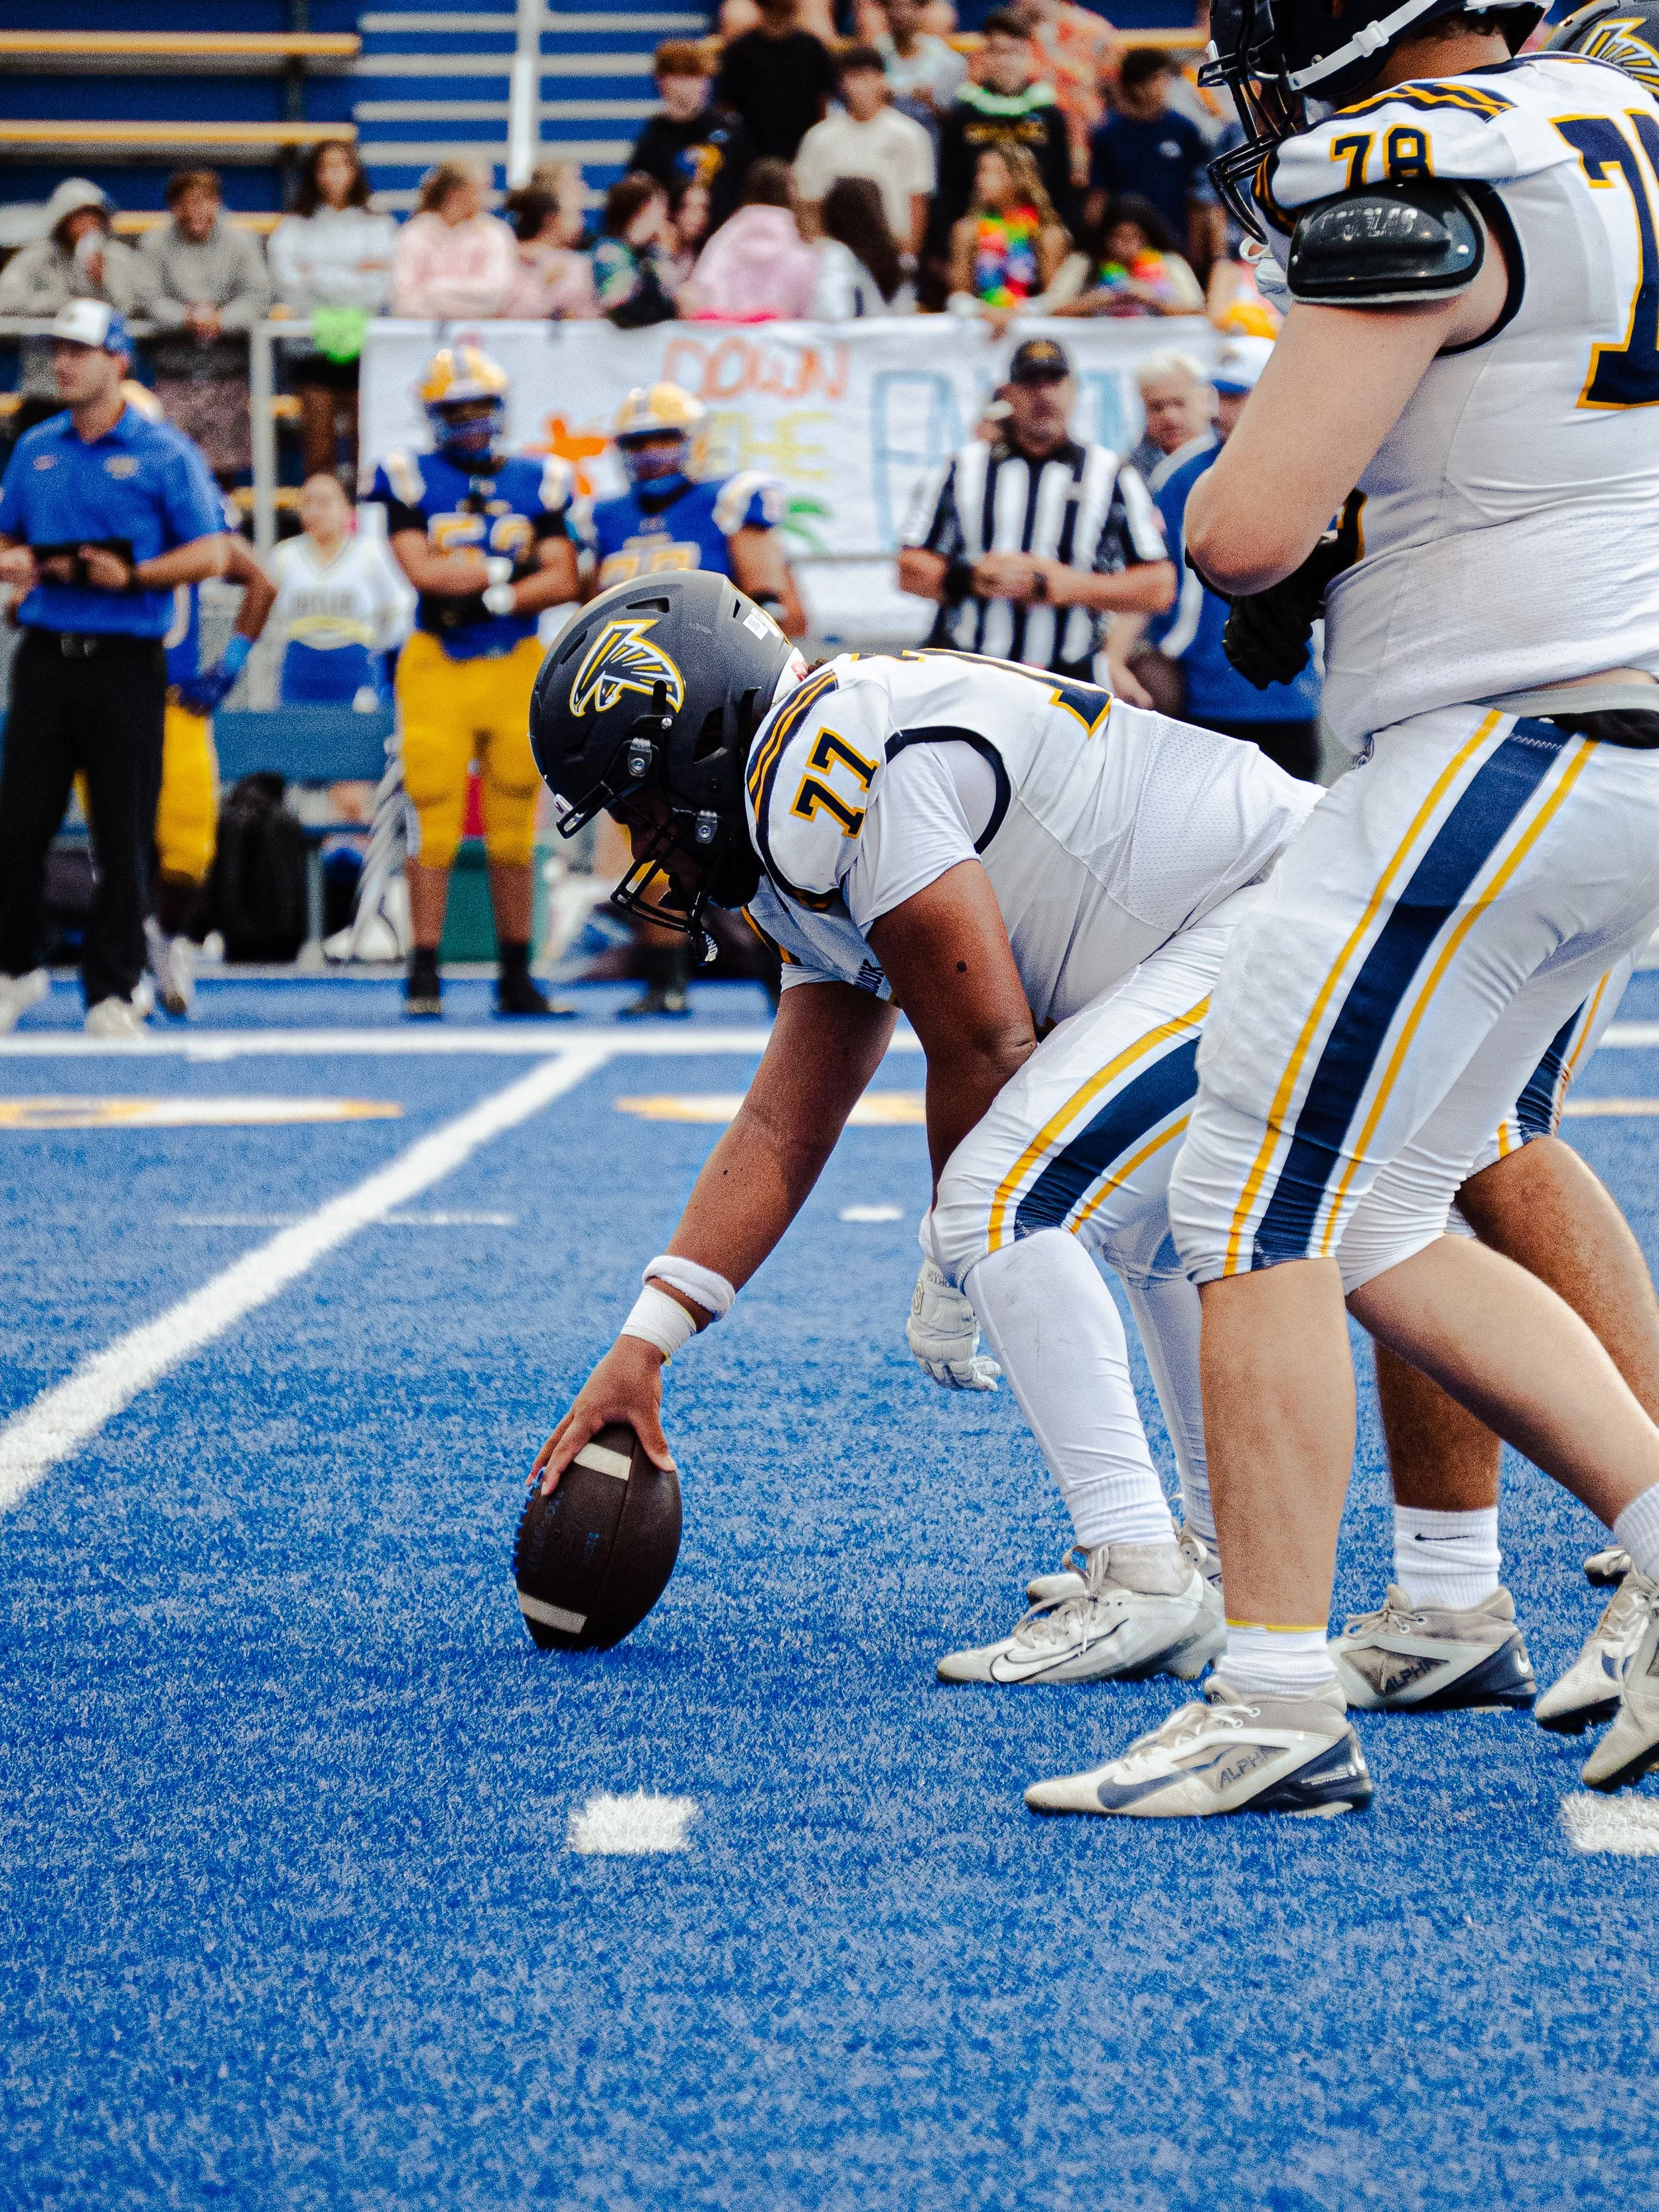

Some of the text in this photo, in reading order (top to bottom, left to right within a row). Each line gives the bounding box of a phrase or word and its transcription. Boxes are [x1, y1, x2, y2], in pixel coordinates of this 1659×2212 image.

[1329, 123, 1435, 192] 78
[662, 338, 850, 401] DOWN
[788, 726, 880, 839] 77
